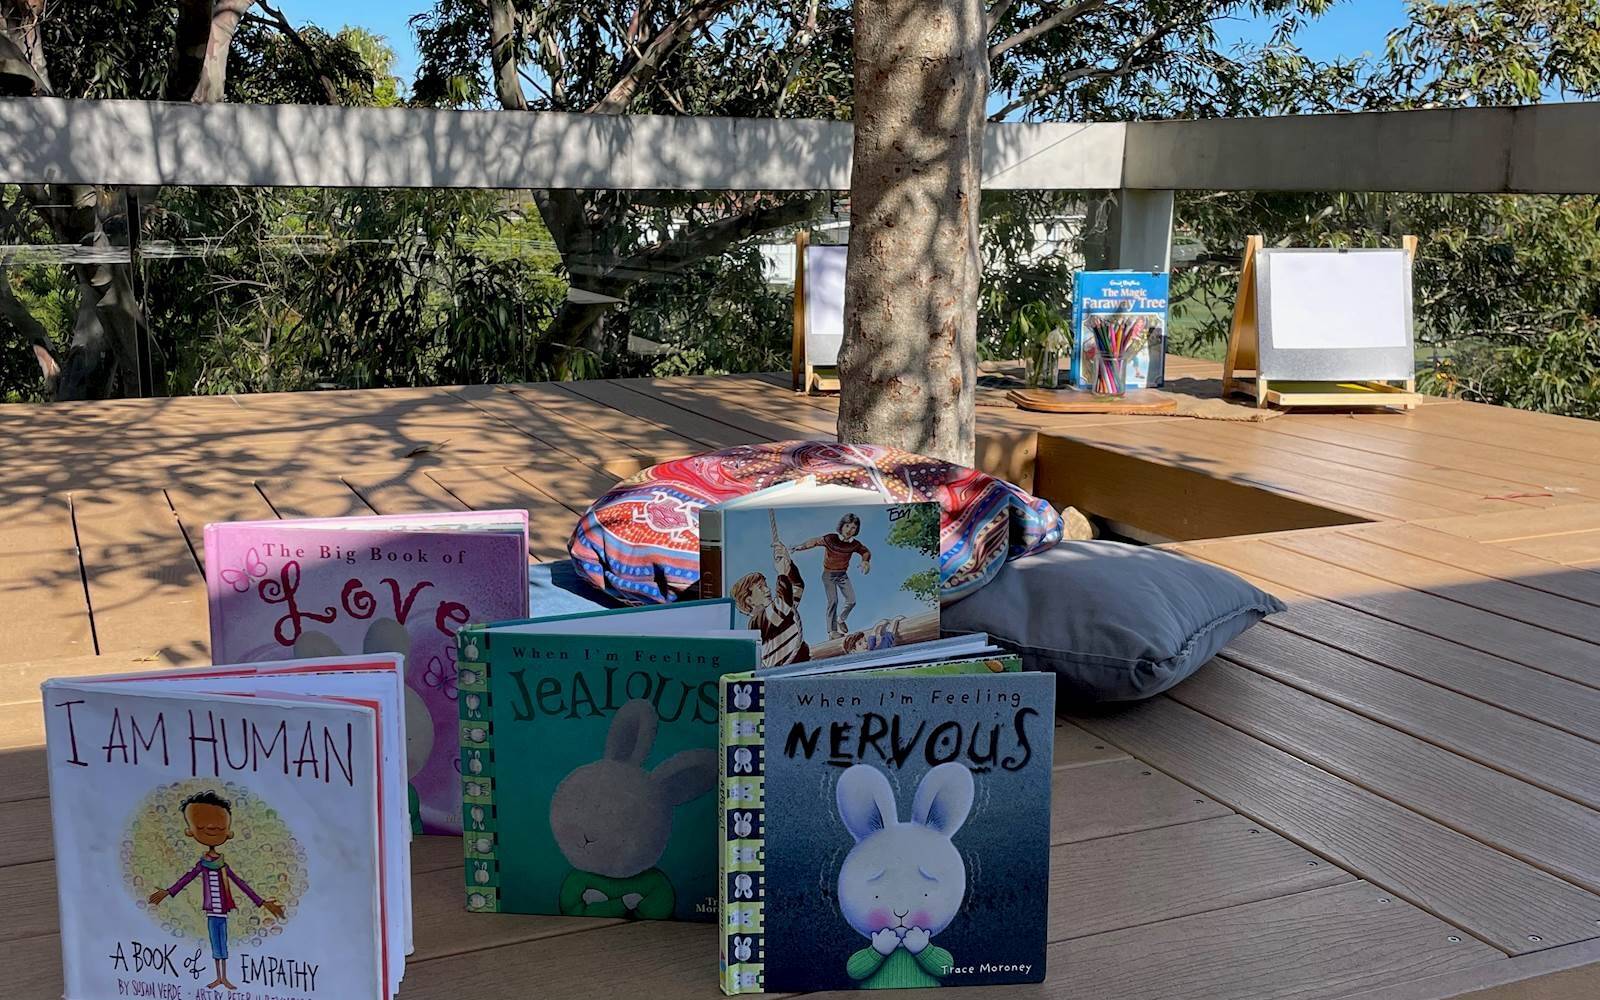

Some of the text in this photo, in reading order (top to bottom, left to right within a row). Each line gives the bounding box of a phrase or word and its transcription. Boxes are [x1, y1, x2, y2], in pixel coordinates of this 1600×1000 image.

[1102, 288, 1148, 300] The Magic
[1082, 297, 1166, 312] Faraway Tree
[263, 544, 466, 565] The Big Book of
[512, 647, 721, 667] When I'm Feeling
[797, 689, 1022, 708] When I'm Feeling
[55, 700, 353, 787] I AM HUMAN
[109, 941, 319, 992] A BOOK of EMPATHY
[941, 963, 1032, 975] Trace Moroney
[117, 978, 130, 996] BY
[131, 980, 156, 998] SUSAN
[157, 982, 182, 1000] VERDE
